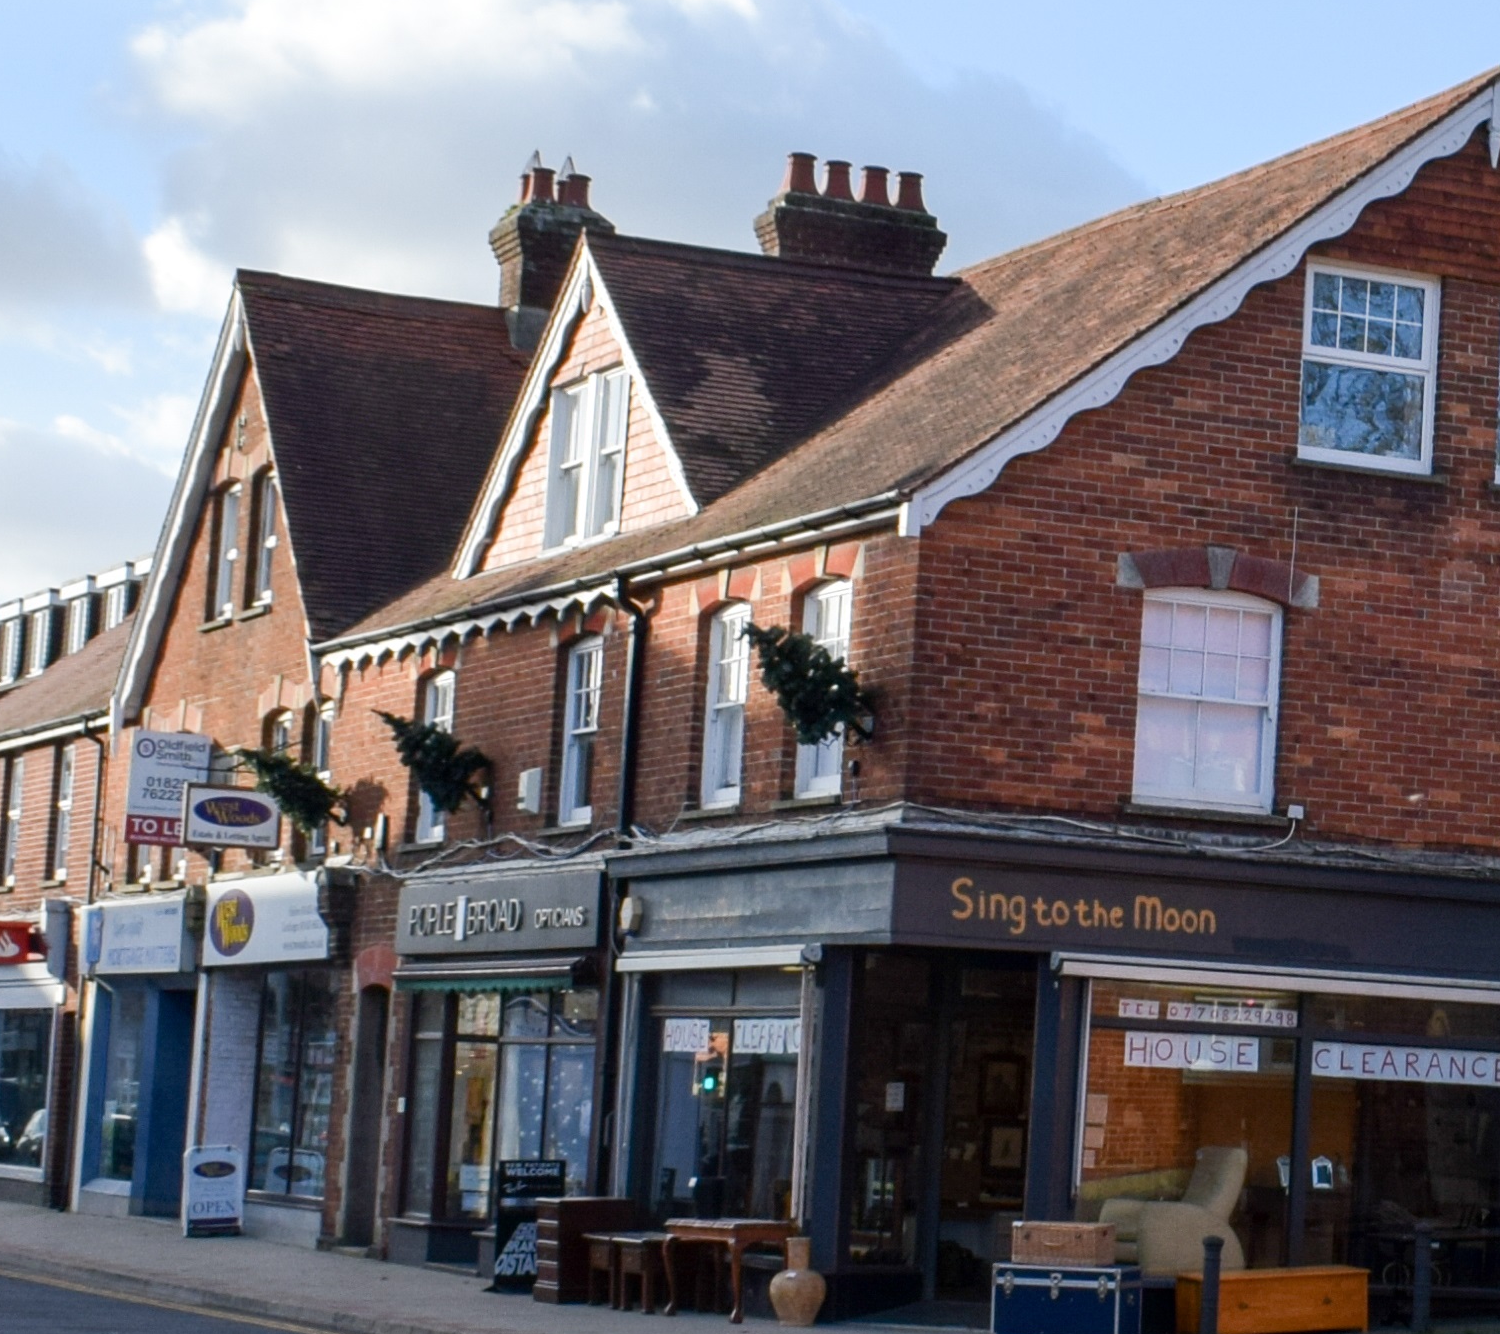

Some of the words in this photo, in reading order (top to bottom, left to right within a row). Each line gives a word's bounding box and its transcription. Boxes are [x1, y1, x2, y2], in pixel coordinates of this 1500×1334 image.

[156, 739, 206, 752] Oldfield
[156, 750, 192, 760] Smith
[205, 801, 238, 814] West
[214, 809, 261, 823] Woods
[132, 818, 157, 833] TO
[216, 831, 221, 839] &
[951, 877, 1026, 935] Sing
[1032, 896, 1070, 927] to
[1073, 898, 1124, 929] the
[1134, 894, 1217, 934] Moon
[409, 902, 456, 936] POPLE
[466, 898, 521, 935] BROAD
[534, 906, 585, 929] OPTICIANS
[1121, 1002, 1158, 1015] TEL
[666, 1023, 708, 1049] HOUSE
[1129, 1037, 1253, 1066] HOUSE
[505, 1167, 560, 1177] WELCOME
[193, 1200, 236, 1215] OPEN
